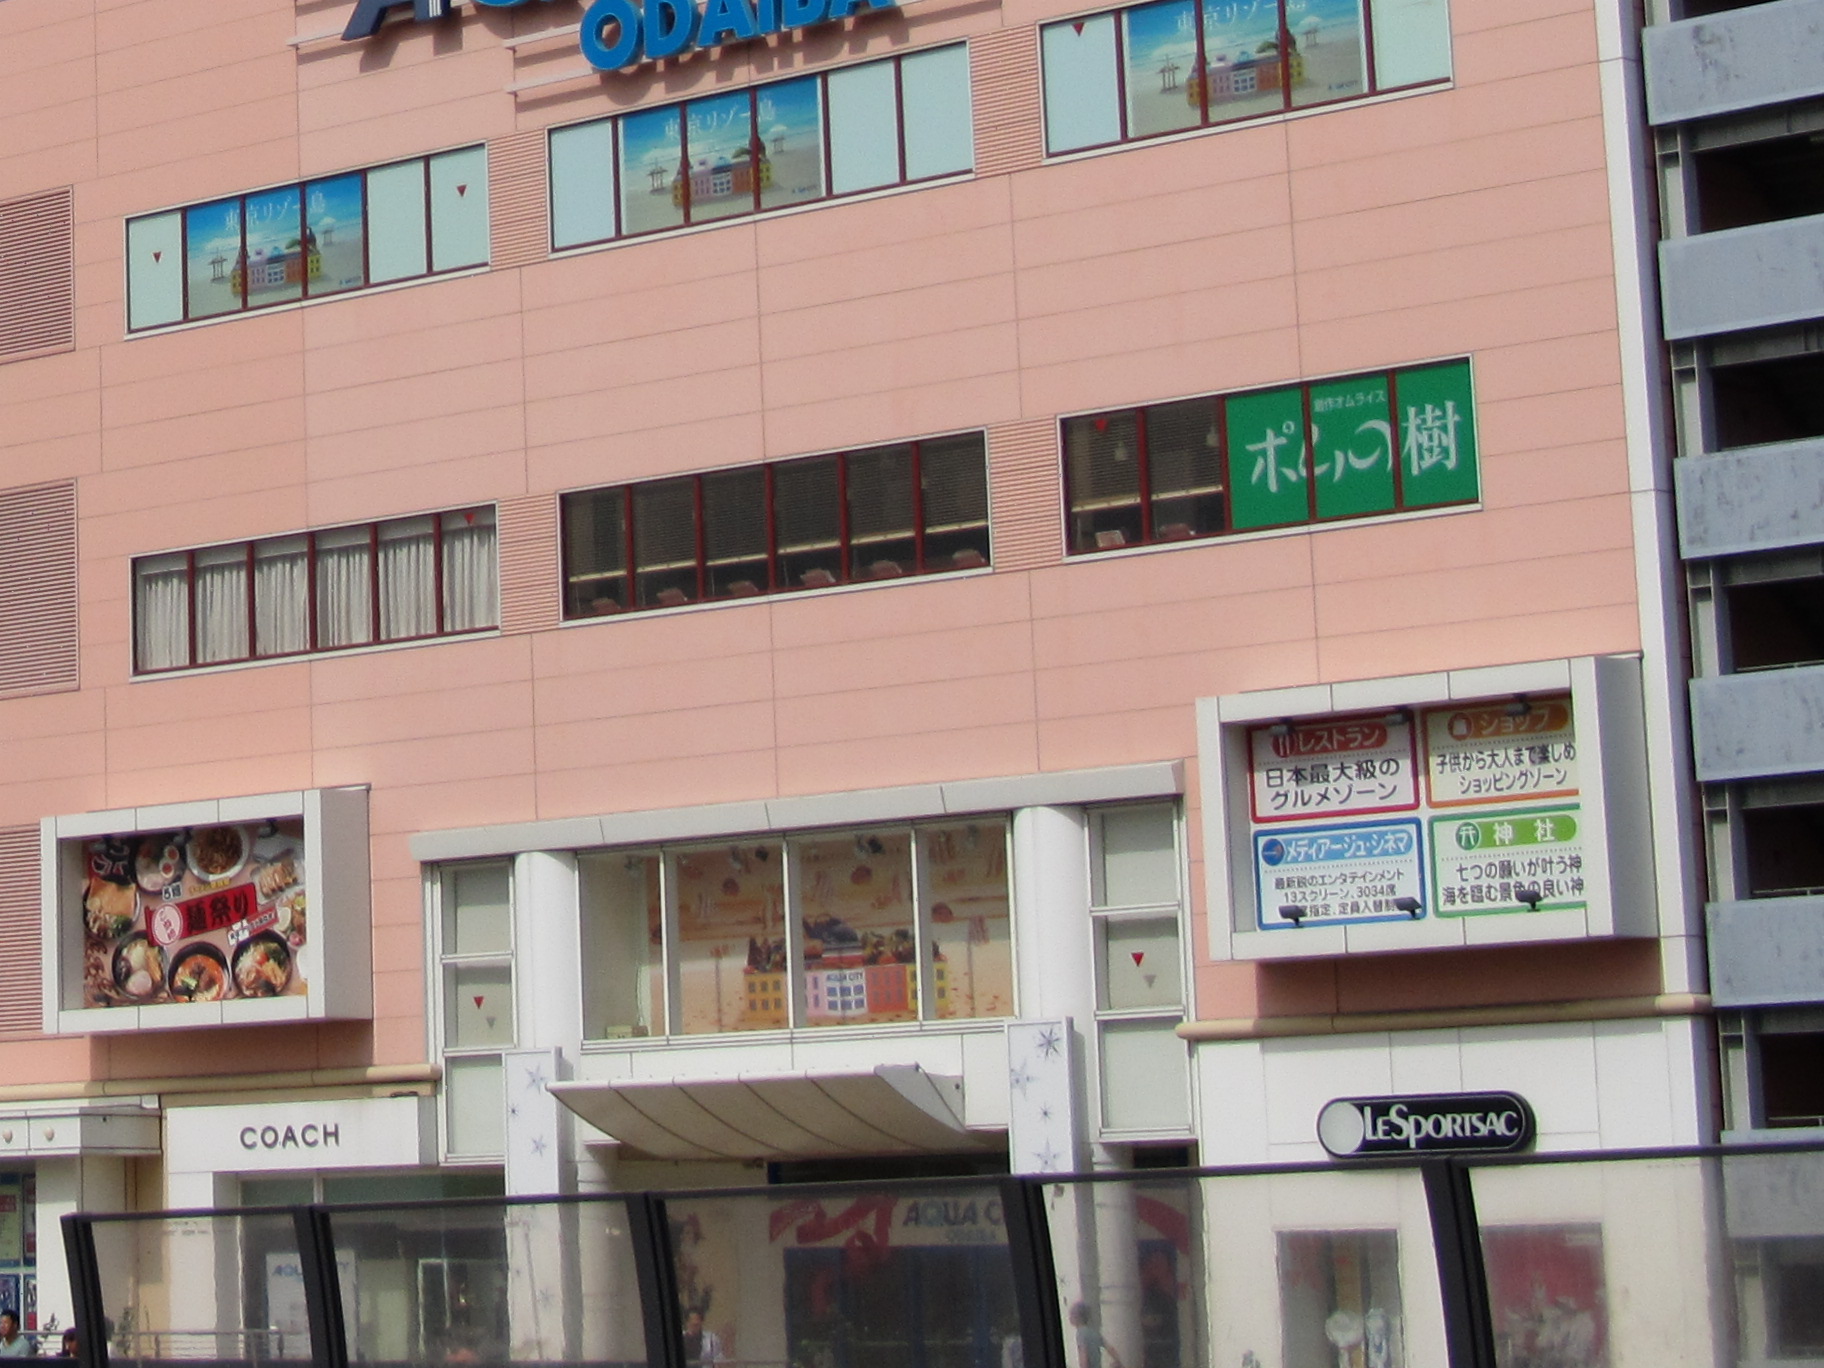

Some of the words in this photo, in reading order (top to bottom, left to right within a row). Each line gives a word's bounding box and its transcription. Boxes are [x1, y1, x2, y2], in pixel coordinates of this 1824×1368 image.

[1479, 706, 1551, 734] ショップ
[1299, 726, 1379, 752] レストラン
[1265, 758, 1400, 788] 日本最大級の
[1459, 768, 1567, 794] ショッピングゾーン
[1271, 783, 1398, 810] グルメゾーン
[240, 1123, 340, 1150] COACH
